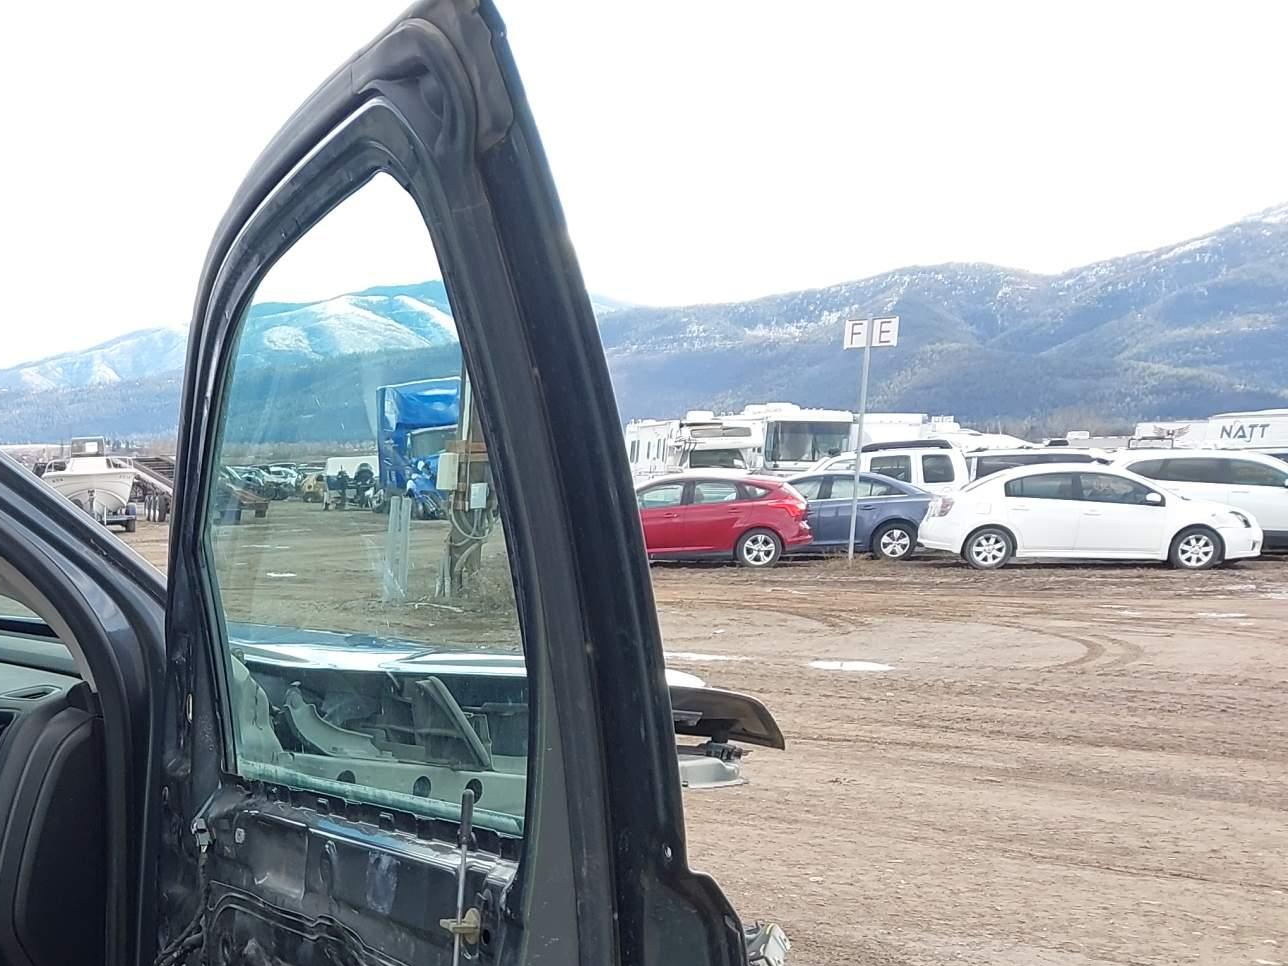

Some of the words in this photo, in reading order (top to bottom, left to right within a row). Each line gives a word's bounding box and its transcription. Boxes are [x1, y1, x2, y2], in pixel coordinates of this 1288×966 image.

[850, 322, 864, 345] F
[878, 320, 893, 344] E
[1220, 423, 1271, 443] NATT
